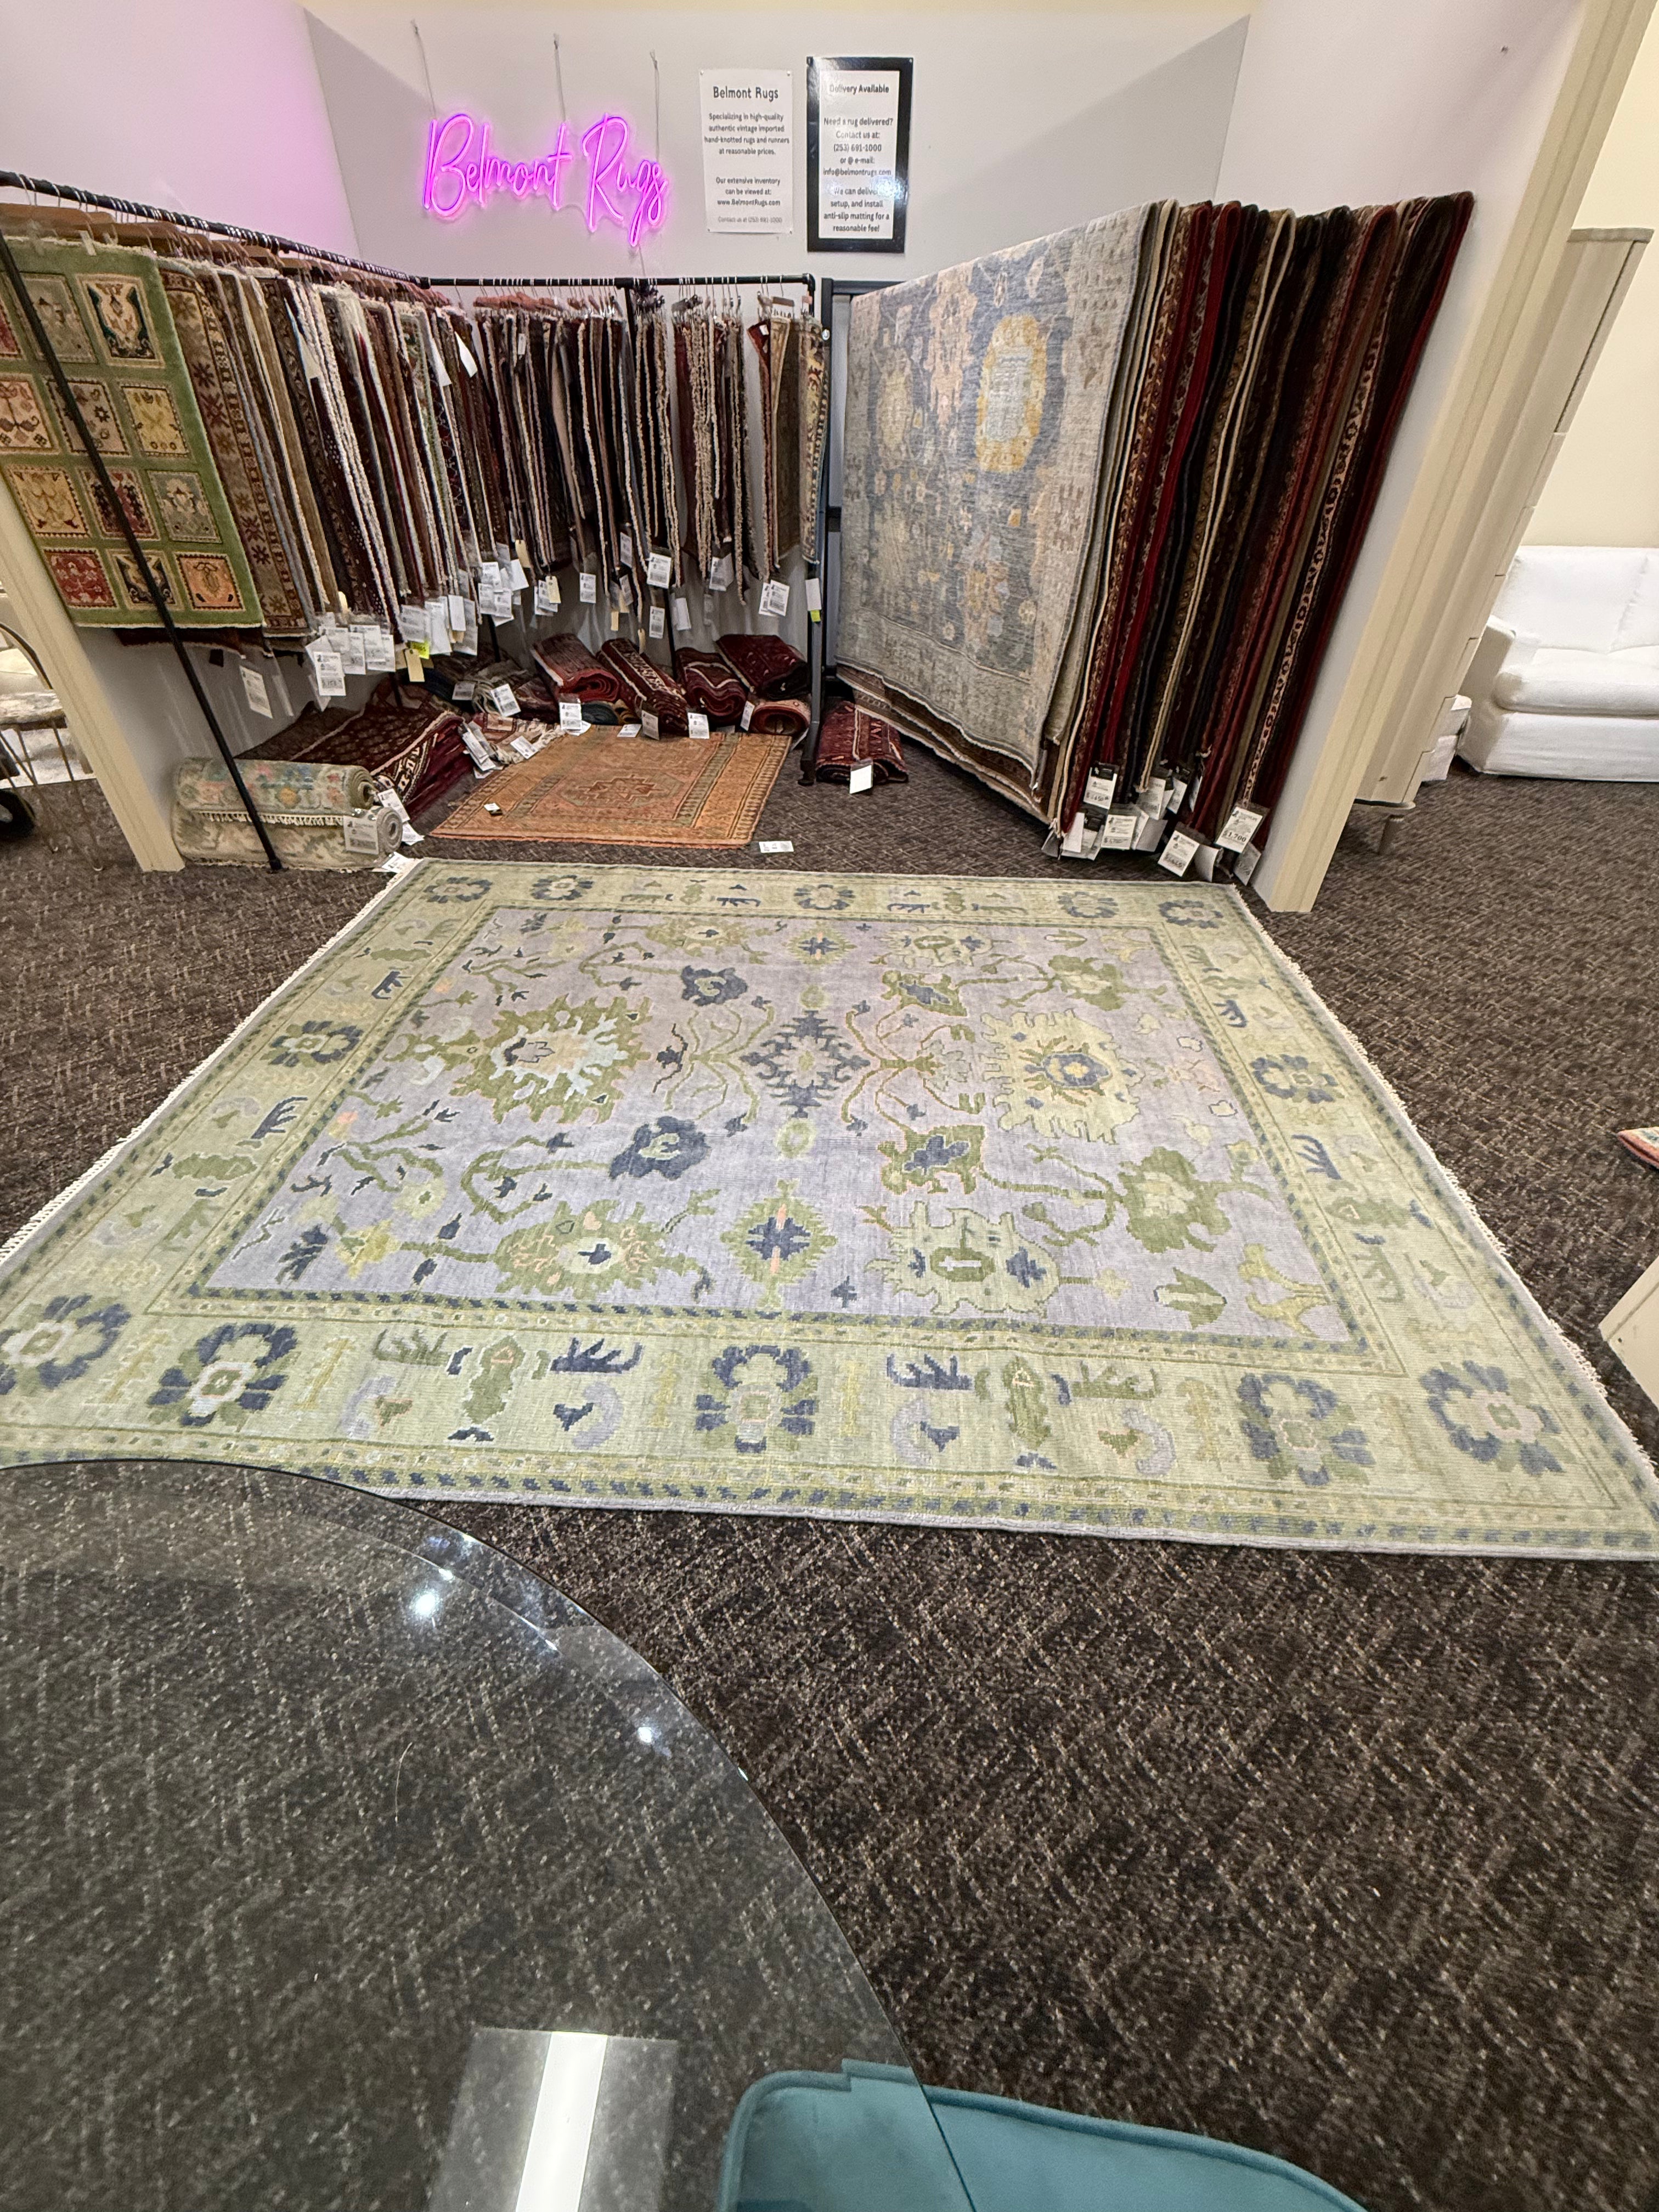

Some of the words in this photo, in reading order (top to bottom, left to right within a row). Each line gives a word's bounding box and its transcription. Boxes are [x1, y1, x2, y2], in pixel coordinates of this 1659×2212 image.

[829, 83, 857, 95] Delivery
[858, 83, 889, 93] Available
[713, 86, 752, 99] Belmont
[755, 86, 778, 103] Rugs
[709, 112, 742, 122] Specializing
[750, 112, 783, 122] high-quality
[823, 117, 840, 126] Need
[848, 118, 858, 127] rug
[859, 117, 893, 126] delivered?
[709, 124, 735, 132] authentic
[737, 124, 757, 133] vintage
[759, 124, 785, 133] imported
[836, 131, 861, 139] Contact
[758, 148, 776, 156] prices.
[834, 143, 849, 153] (253)
[851, 143, 882, 152] 691-1000
[848, 156, 854, 165] @
[823, 167, 891, 177] info@belmontrugs.com
[423, 112, 573, 216] Belmont
[582, 112, 669, 247] Rugs
[716, 176, 726, 184] Our
[754, 177, 781, 186] inventory
[717, 199, 781, 207] www.BelmontRugs.com
[831, 200, 850, 208] setup,
[851, 199, 863, 207] and
[865, 199, 883, 207] install
[823, 212, 849, 221] anti-slip
[850, 212, 874, 222] matting
[875, 212, 884, 220] for
